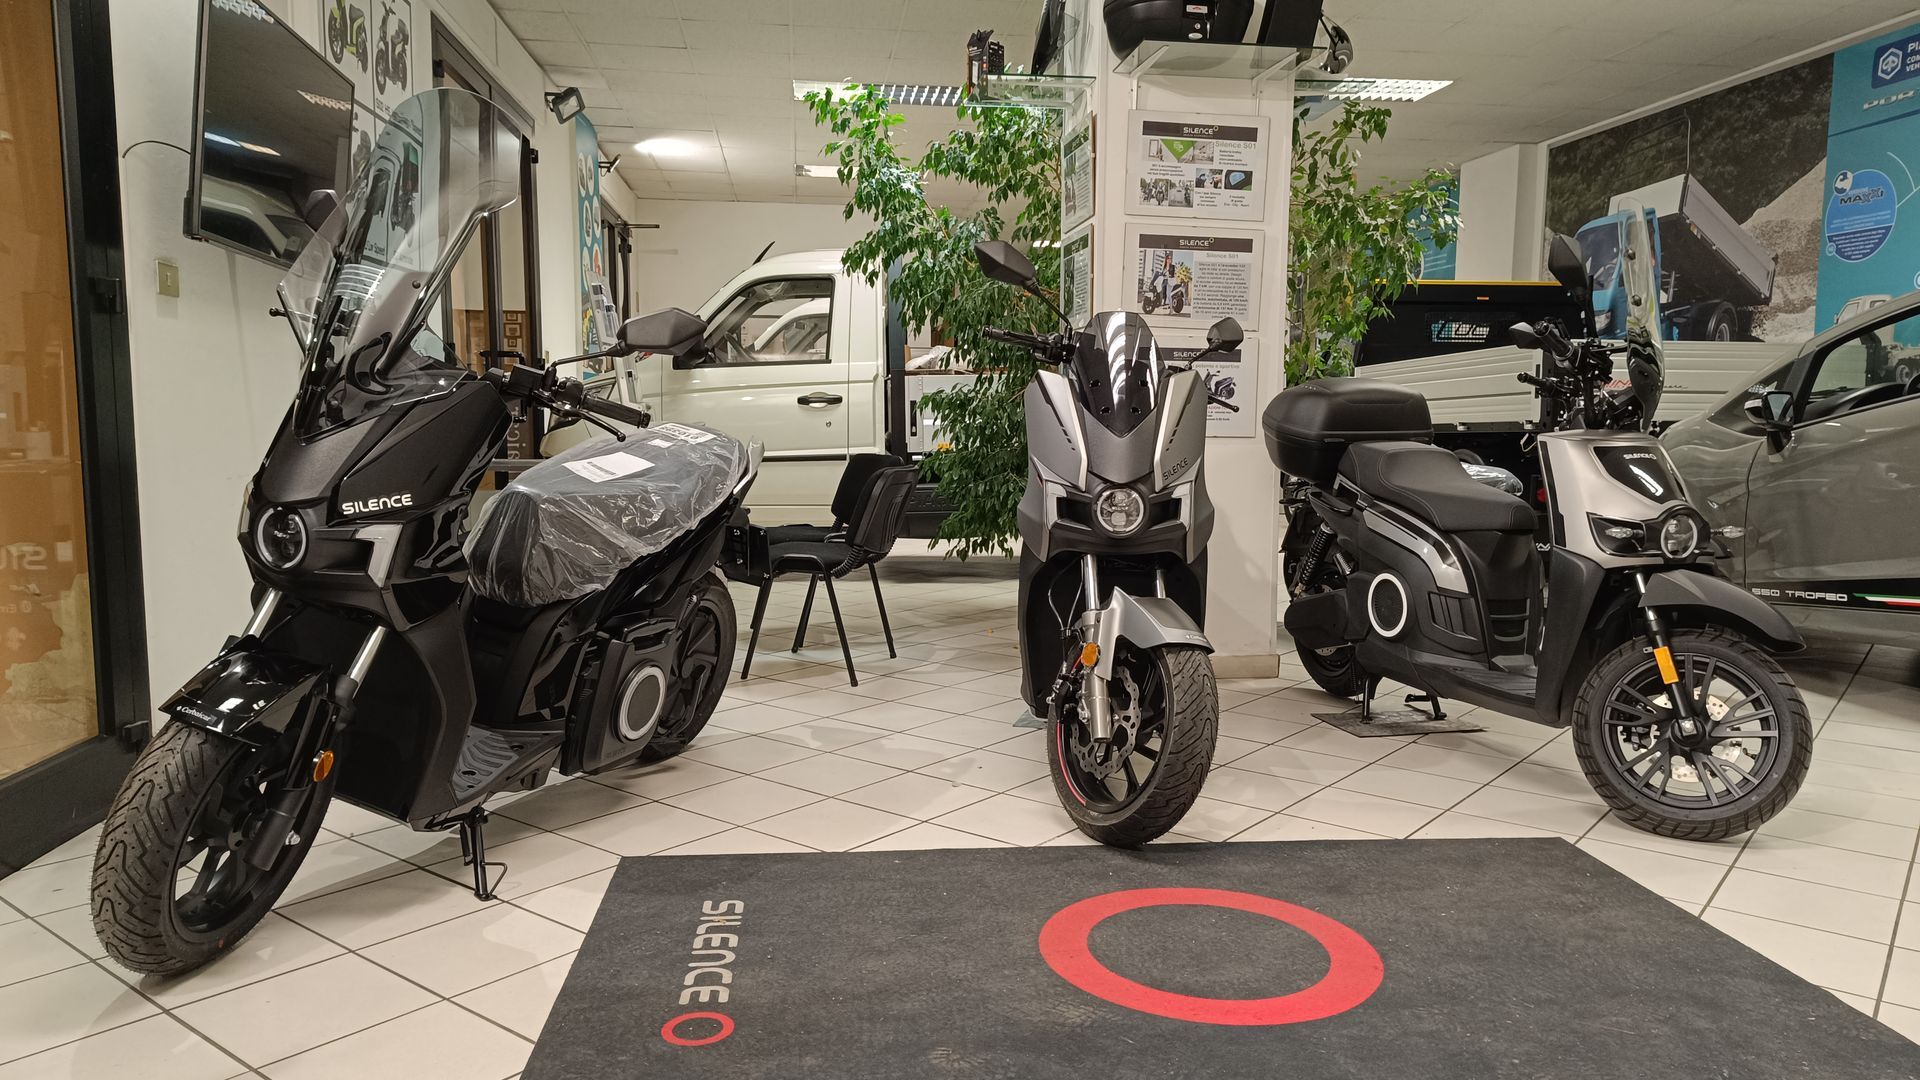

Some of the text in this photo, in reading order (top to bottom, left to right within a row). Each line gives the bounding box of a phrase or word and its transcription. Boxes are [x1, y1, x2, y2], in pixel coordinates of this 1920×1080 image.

[1908, 41, 1920, 53] PI
[1183, 126, 1213, 135] SILENCE
[1215, 141, 1257, 151] Silence S01
[1179, 239, 1209, 247] SILENCE
[1162, 457, 1188, 480] SILENCE
[342, 493, 413, 515] SILENCE
[1751, 588, 1848, 602] 550 TROFEO
[678, 900, 745, 1005] SILENCE
